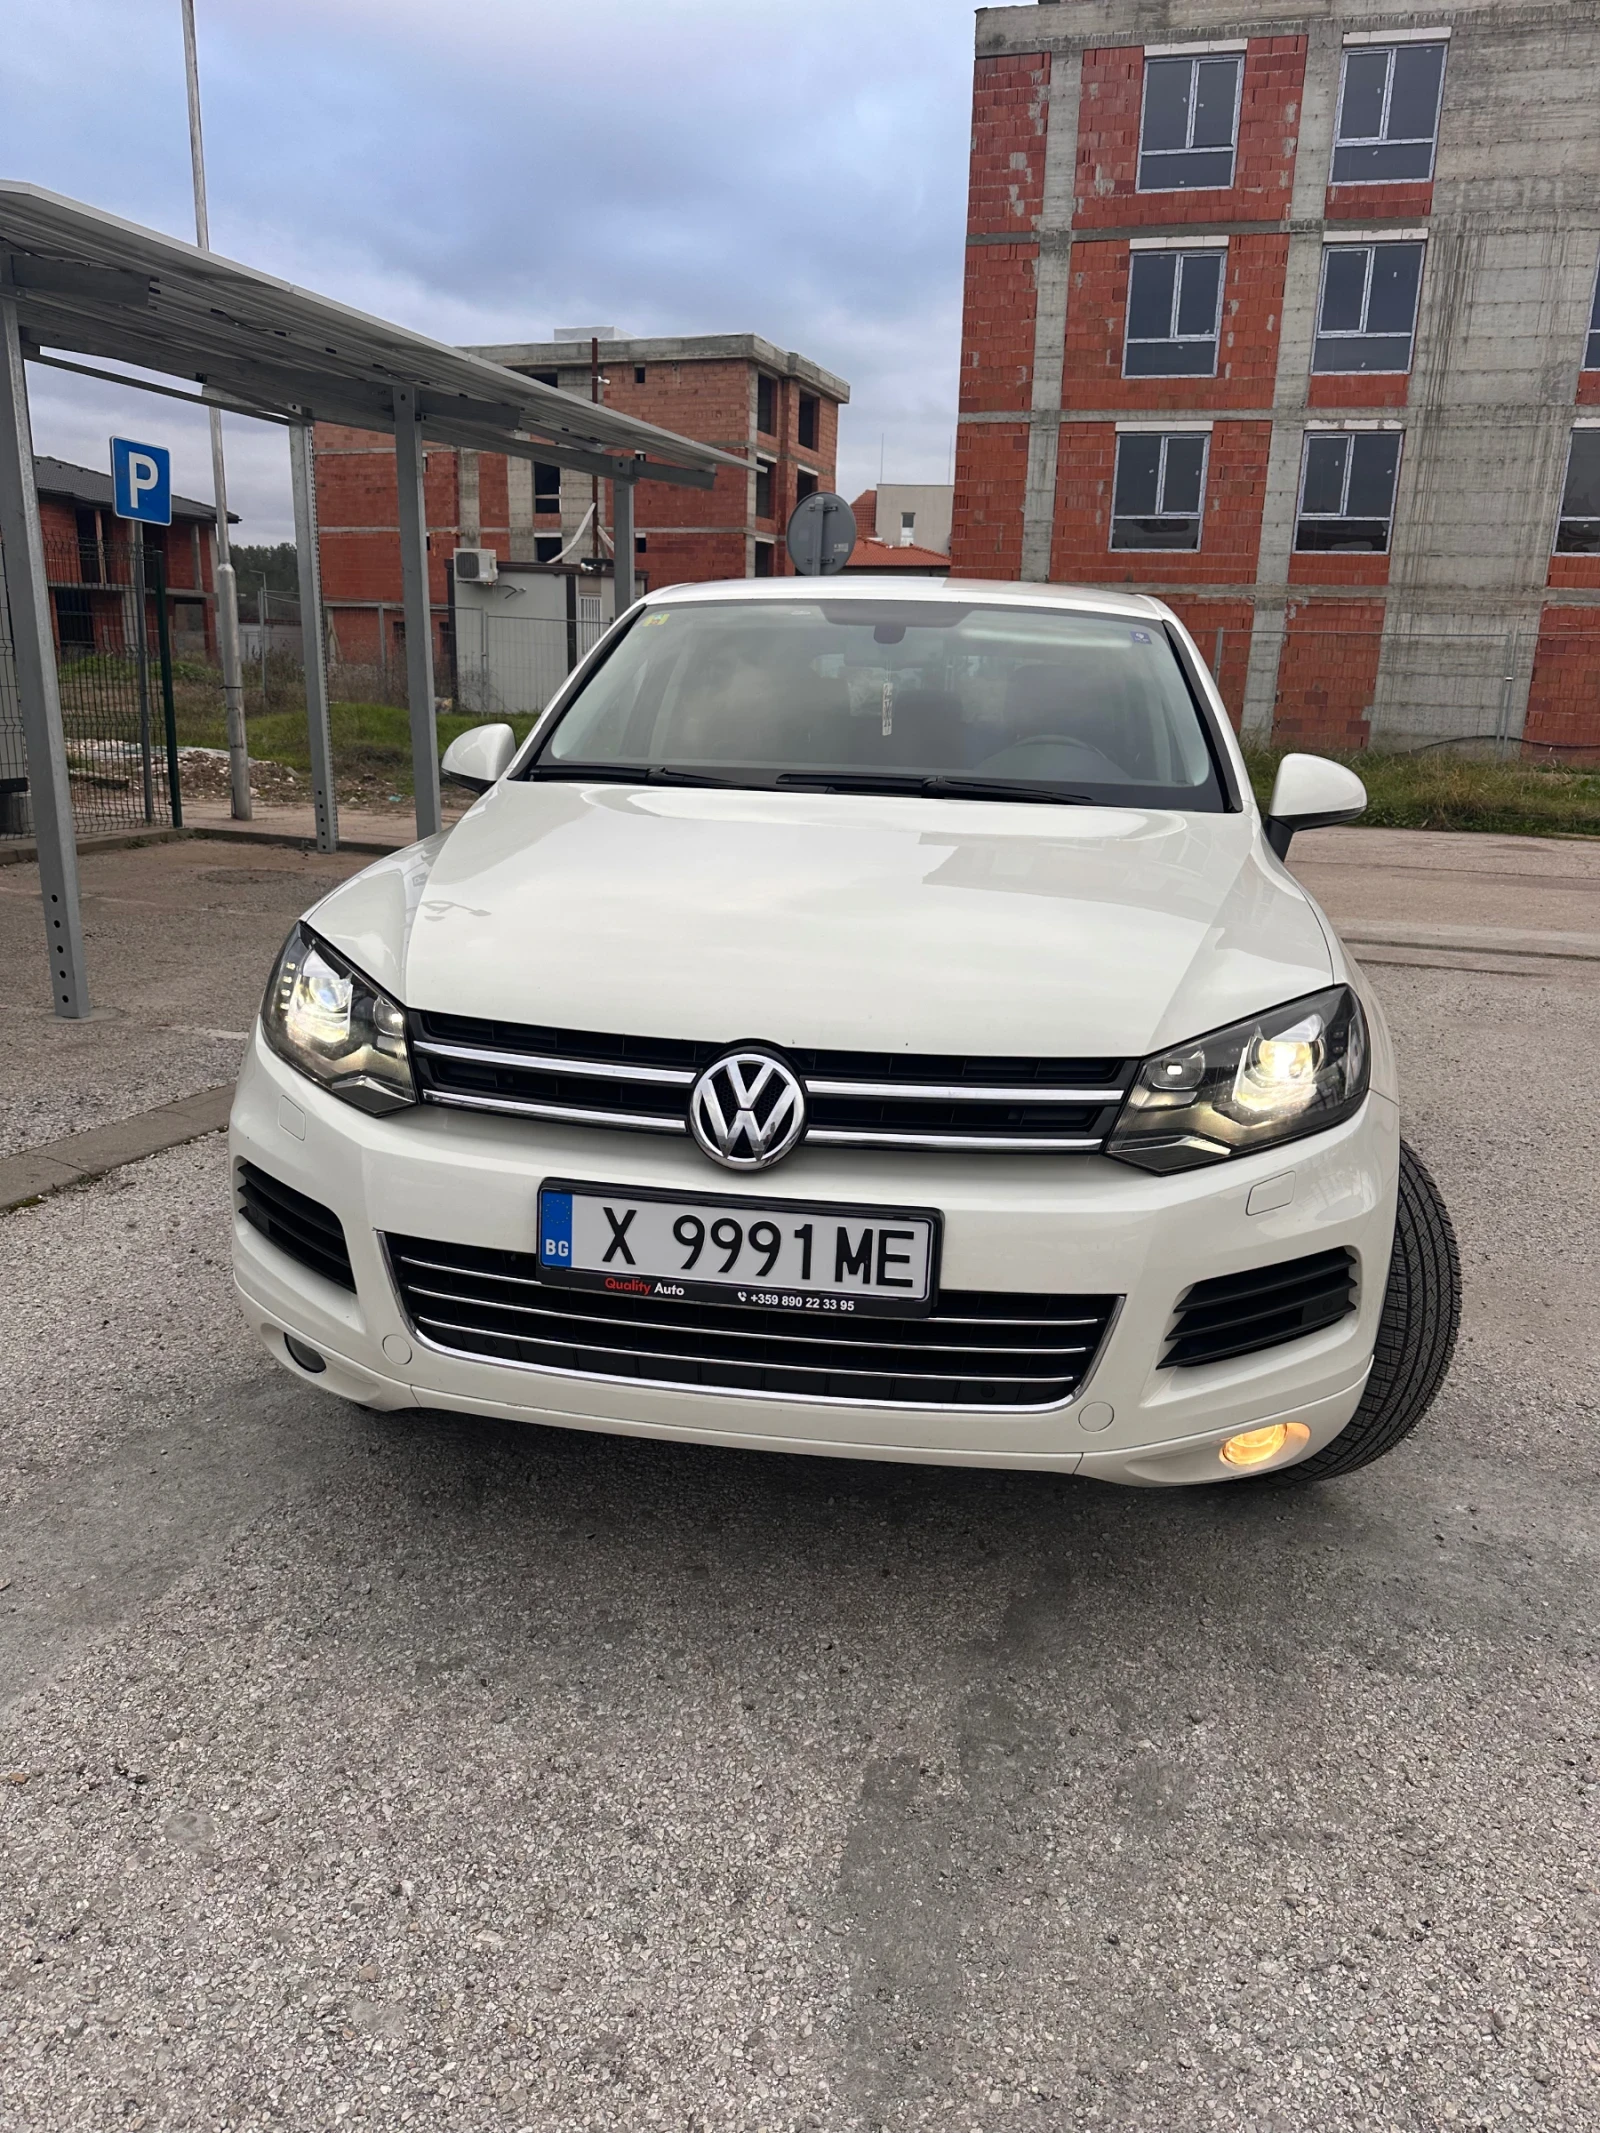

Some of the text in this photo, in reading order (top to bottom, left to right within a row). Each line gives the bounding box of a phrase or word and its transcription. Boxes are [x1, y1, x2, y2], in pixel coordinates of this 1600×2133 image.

[128, 451, 159, 509] P
[545, 1238, 569, 1257] BG
[602, 1206, 915, 1288] X 9991 ME
[605, 1277, 685, 1296] Quality Auto
[750, 1293, 855, 1312] +359 890 22 33 95
